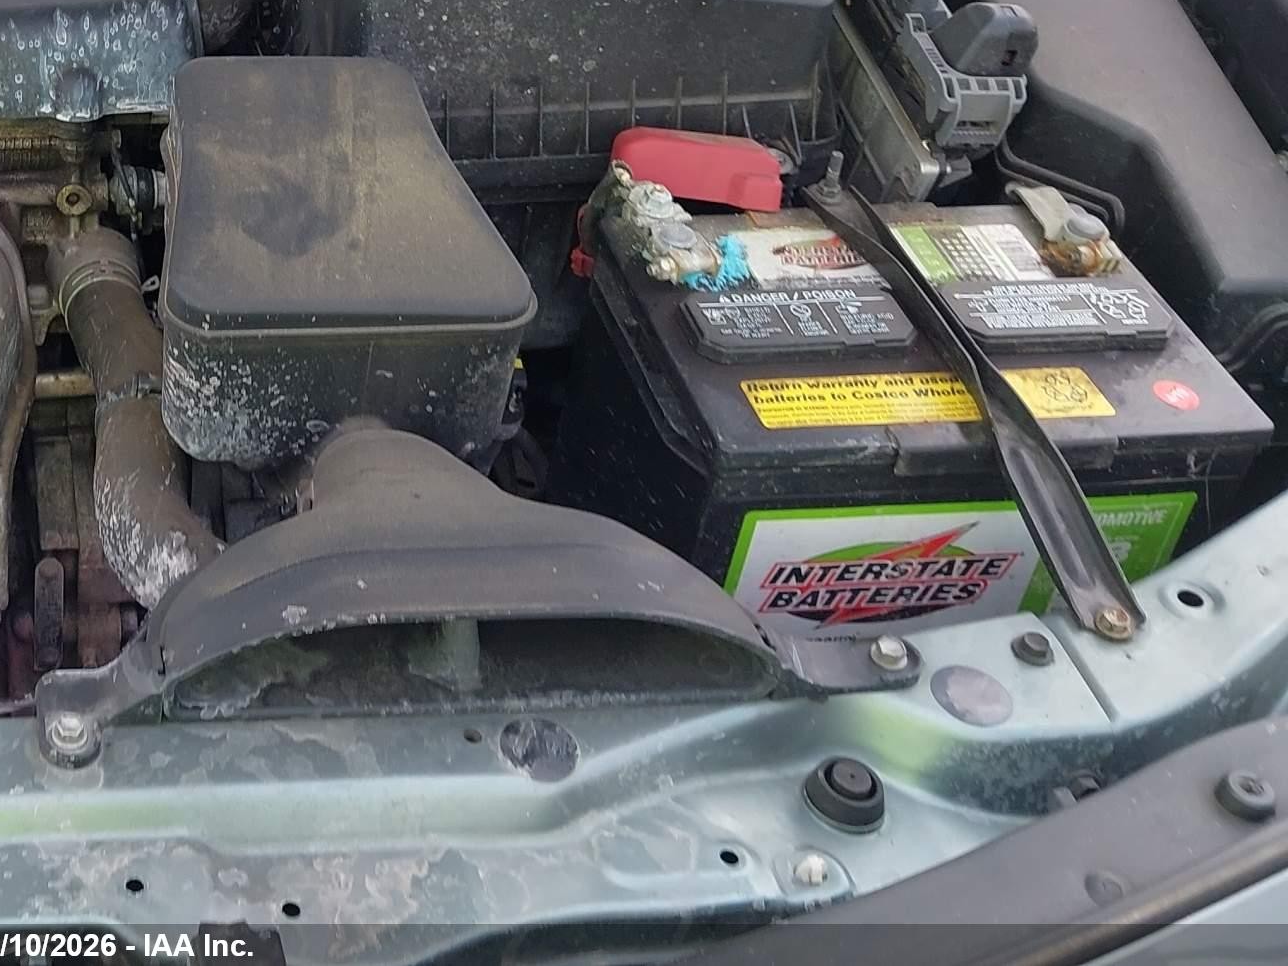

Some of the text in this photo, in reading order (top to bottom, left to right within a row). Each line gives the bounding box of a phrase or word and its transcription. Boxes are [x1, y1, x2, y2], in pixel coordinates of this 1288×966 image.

[731, 292, 790, 304] DANGER
[803, 289, 857, 300] POISON
[746, 382, 802, 393] Return
[807, 379, 878, 391] warranty
[885, 377, 914, 386] and
[754, 386, 966, 404] batteries to Costco Whole
[1096, 509, 1168, 527] OMOTIVE
[768, 557, 1011, 585] INTERSTATE
[767, 582, 982, 610] BATTERIES
